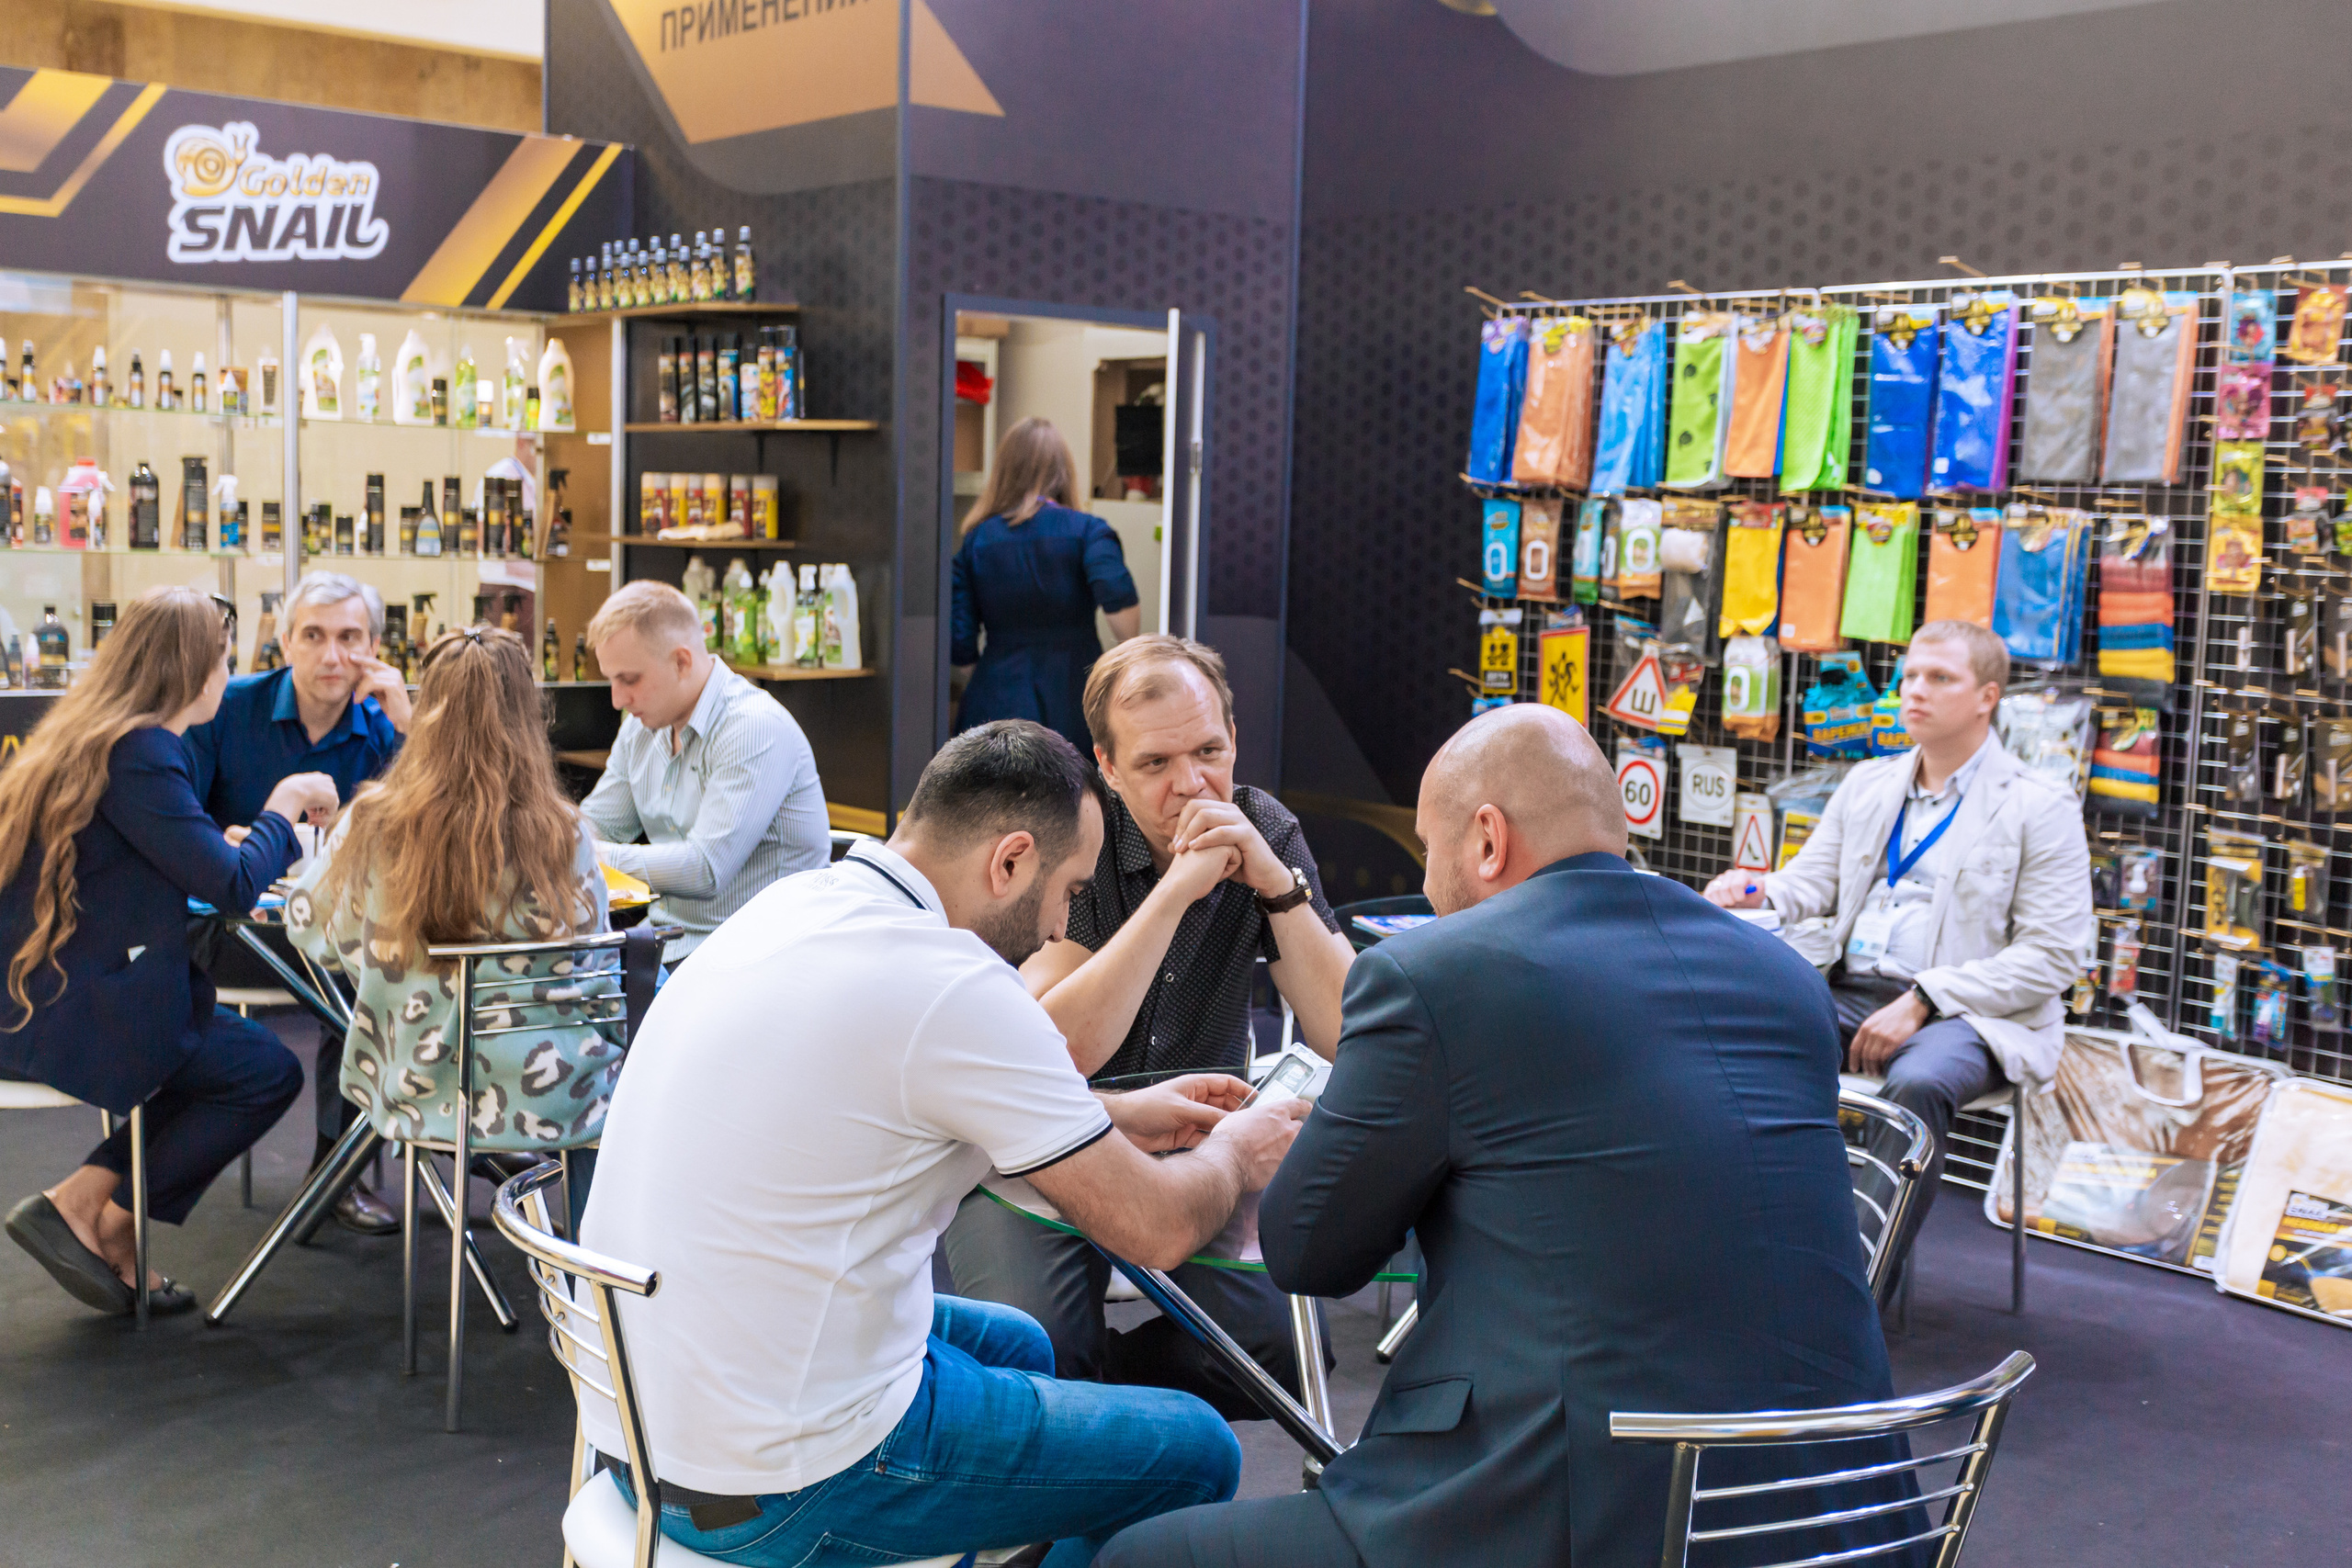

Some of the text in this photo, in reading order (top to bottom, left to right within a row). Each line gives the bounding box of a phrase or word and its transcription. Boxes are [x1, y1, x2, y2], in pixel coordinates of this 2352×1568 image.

[661, 0, 867, 51] ПРИМЕНЕ
[240, 165, 370, 197] Golden
[179, 204, 381, 250] SNAIL
[1631, 688, 1657, 715] Ш
[1624, 781, 1651, 806] 60
[1691, 773, 1725, 797] RUS
